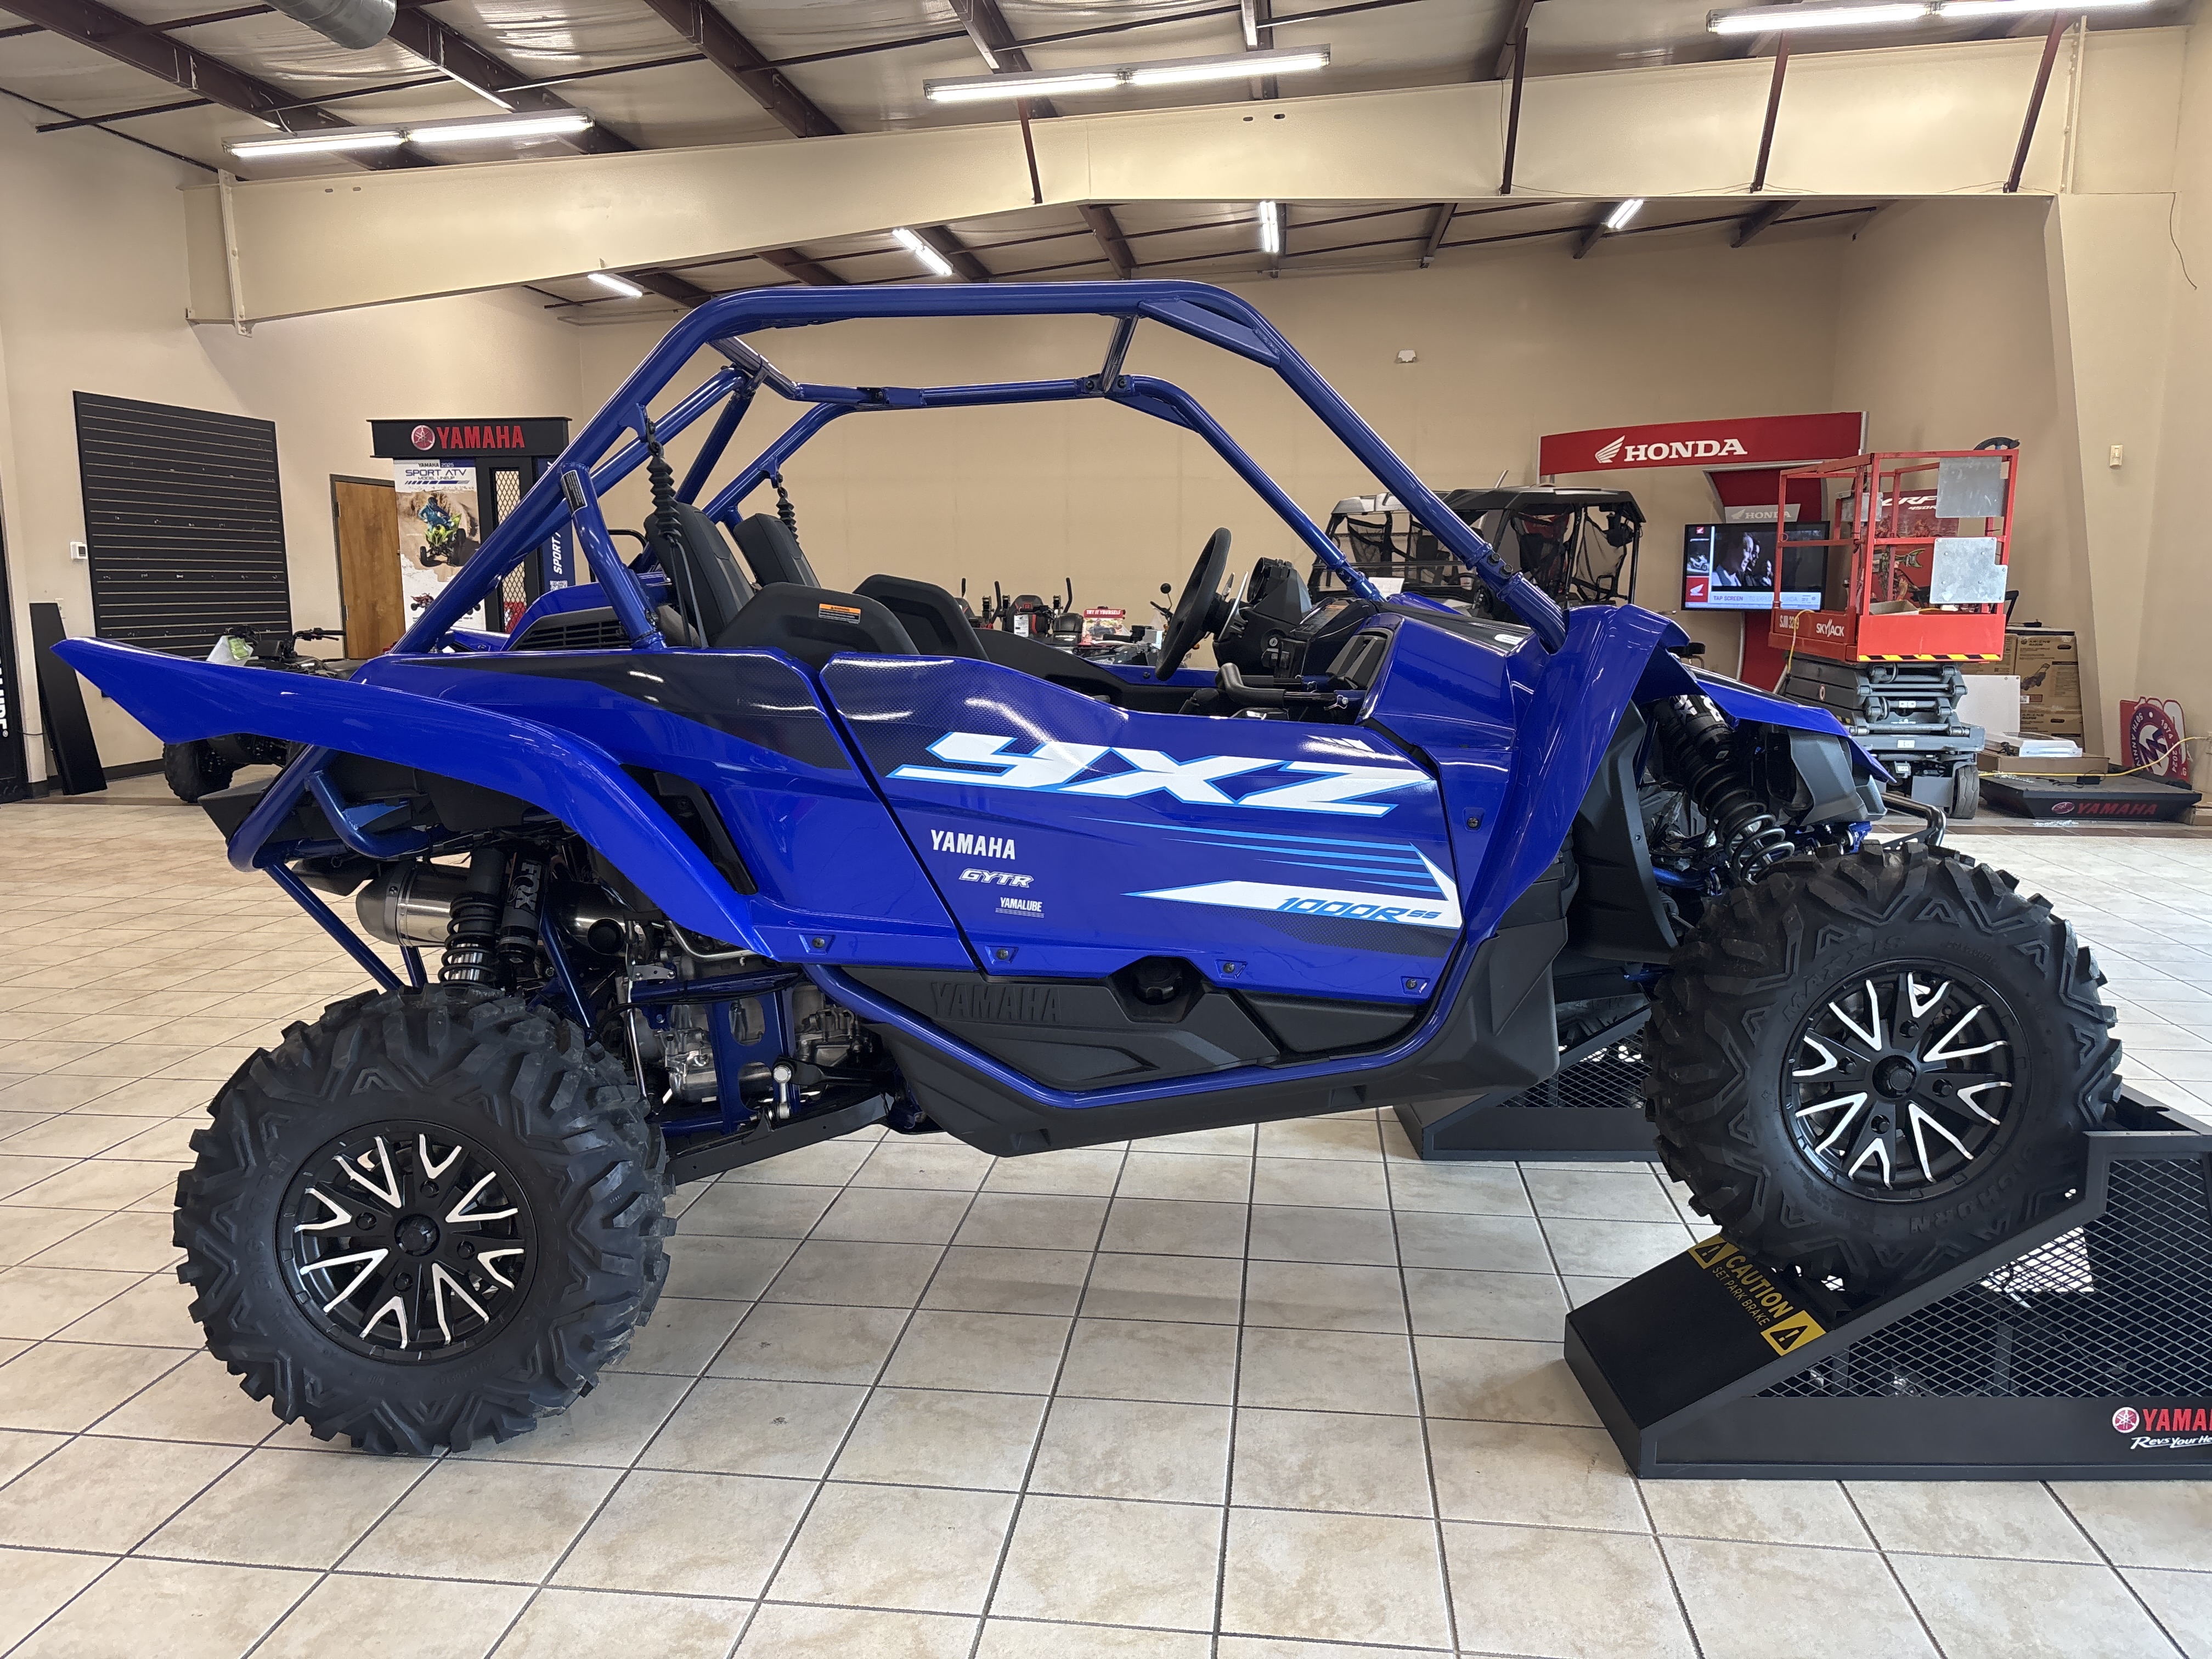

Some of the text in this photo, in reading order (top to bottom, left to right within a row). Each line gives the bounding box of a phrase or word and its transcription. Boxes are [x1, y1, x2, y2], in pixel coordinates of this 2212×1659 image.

[436, 426, 525, 449] YAMAHA
[1624, 438, 1748, 462] HONDA
[551, 535, 562, 575] SPORT
[1788, 616, 1799, 630] 329
[1816, 618, 1845, 637] SKYJACK
[2132, 712, 2143, 733] 50TH
[2160, 719, 2174, 740] 1974
[885, 731, 1437, 817] YXZ
[2076, 801, 2158, 816] YAMAHA
[930, 829, 1015, 860] YAMAHA
[958, 868, 1035, 888] GYTR
[1000, 896, 1043, 912] YAMALUBE
[931, 981, 1062, 1022] YAMAHA
[1712, 1266, 1771, 1327] SET PARK BRAKE
[1725, 1255, 1794, 1318] CAUTION
[2142, 1408, 2212, 1432] YAMA
[2130, 1436, 2171, 1449] Revs
[2169, 1436, 2199, 1448] Your
